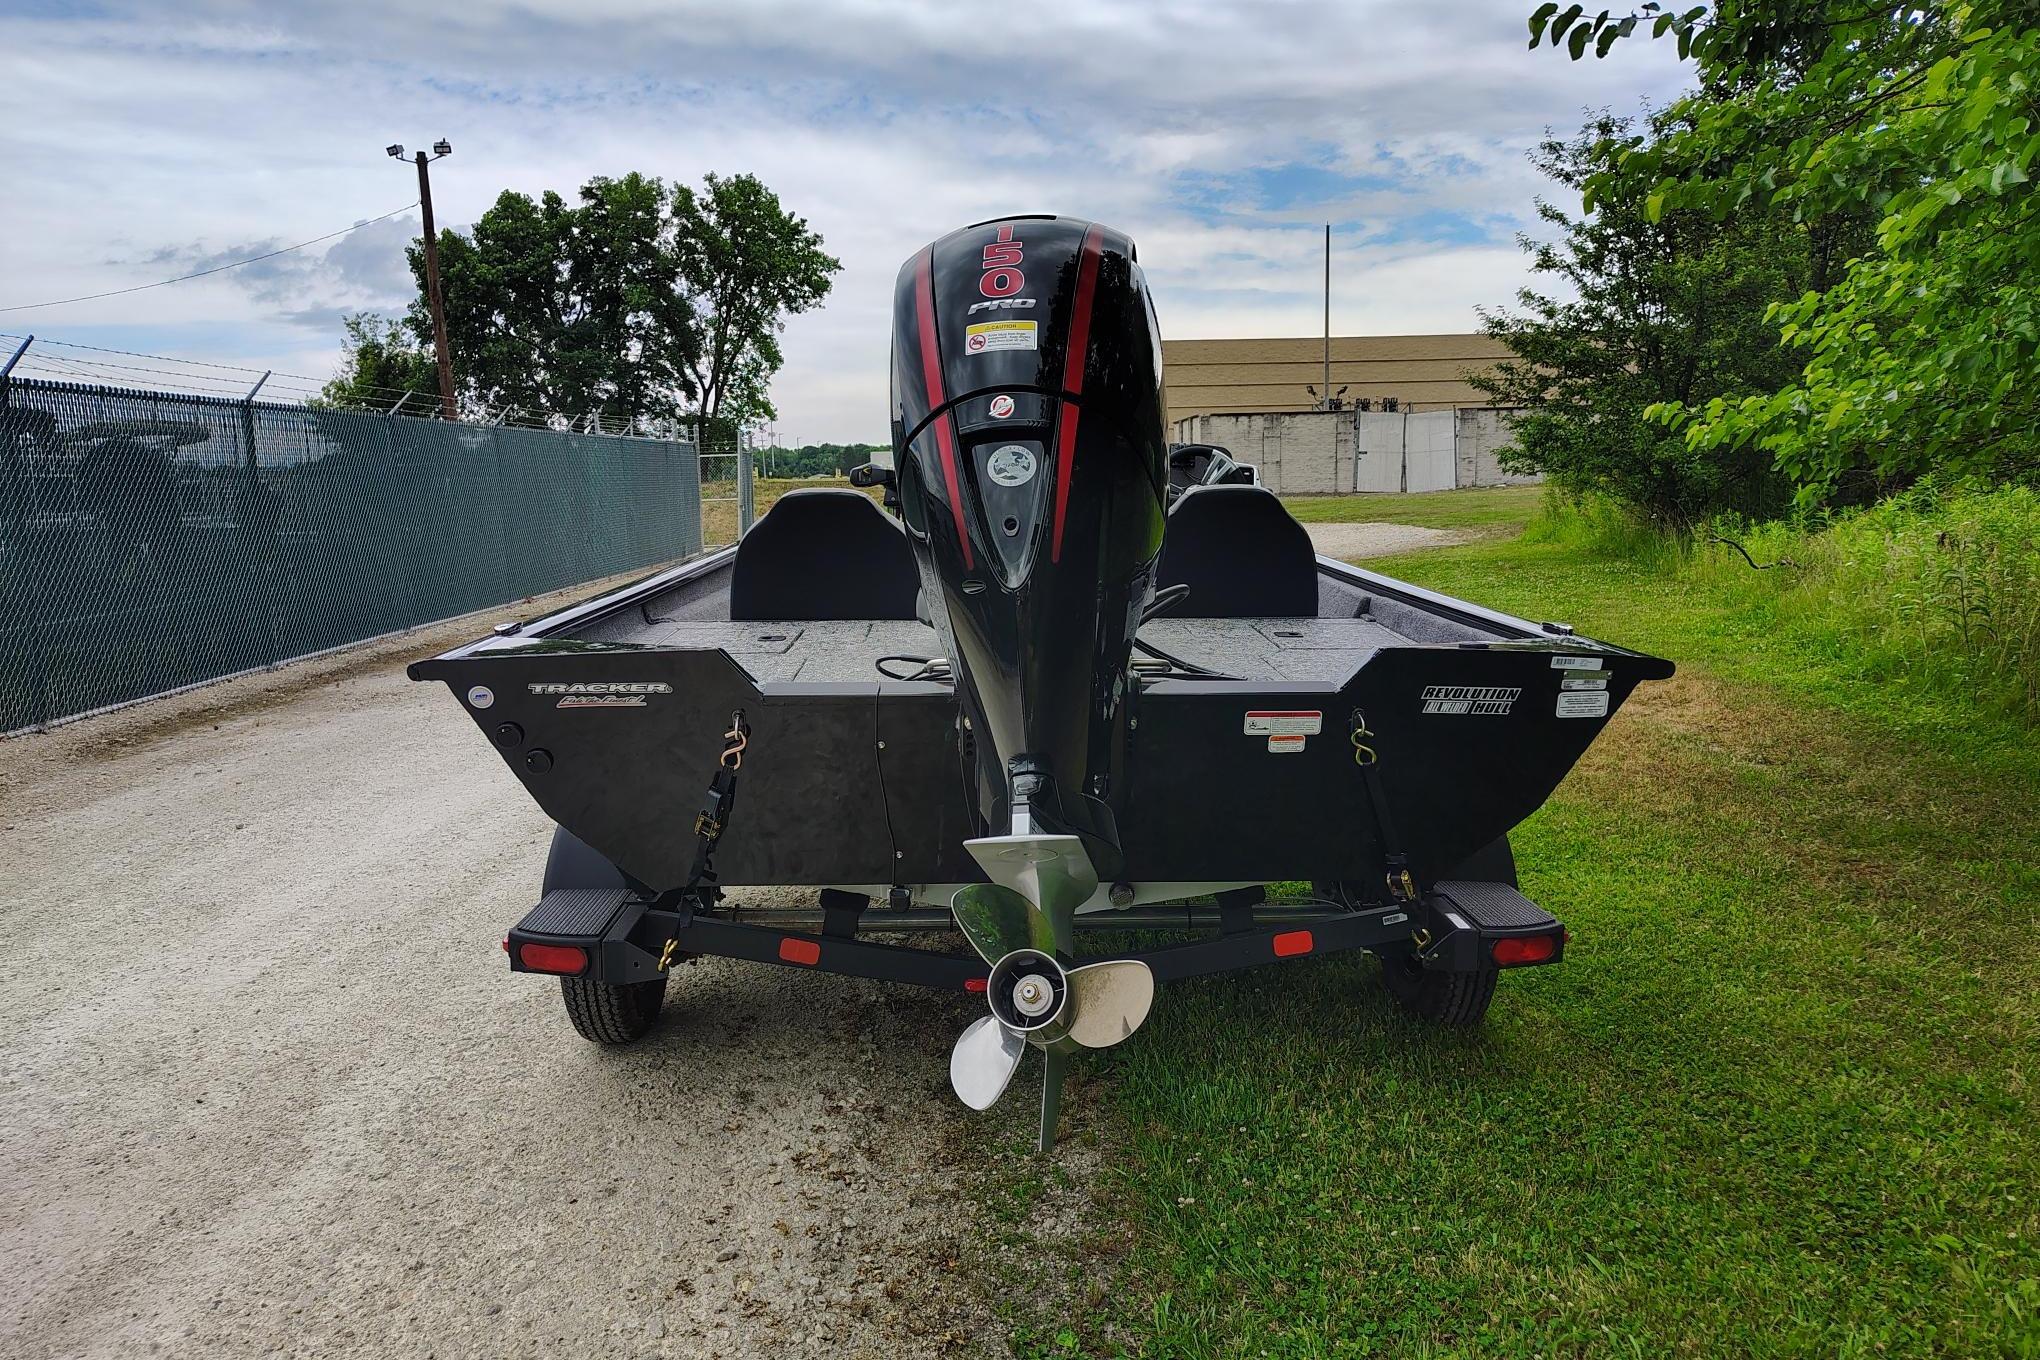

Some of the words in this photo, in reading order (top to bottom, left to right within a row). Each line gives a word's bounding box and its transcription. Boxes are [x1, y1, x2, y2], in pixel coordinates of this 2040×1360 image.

[980, 224, 1025, 298] 150
[967, 298, 1037, 315] PRO
[528, 683, 668, 695] TRACKER
[1422, 686, 1521, 701] REVOLUTION
[1427, 701, 1441, 712] ALL
[1440, 702, 1469, 713] WELDED
[1471, 701, 1512, 714] HULL
